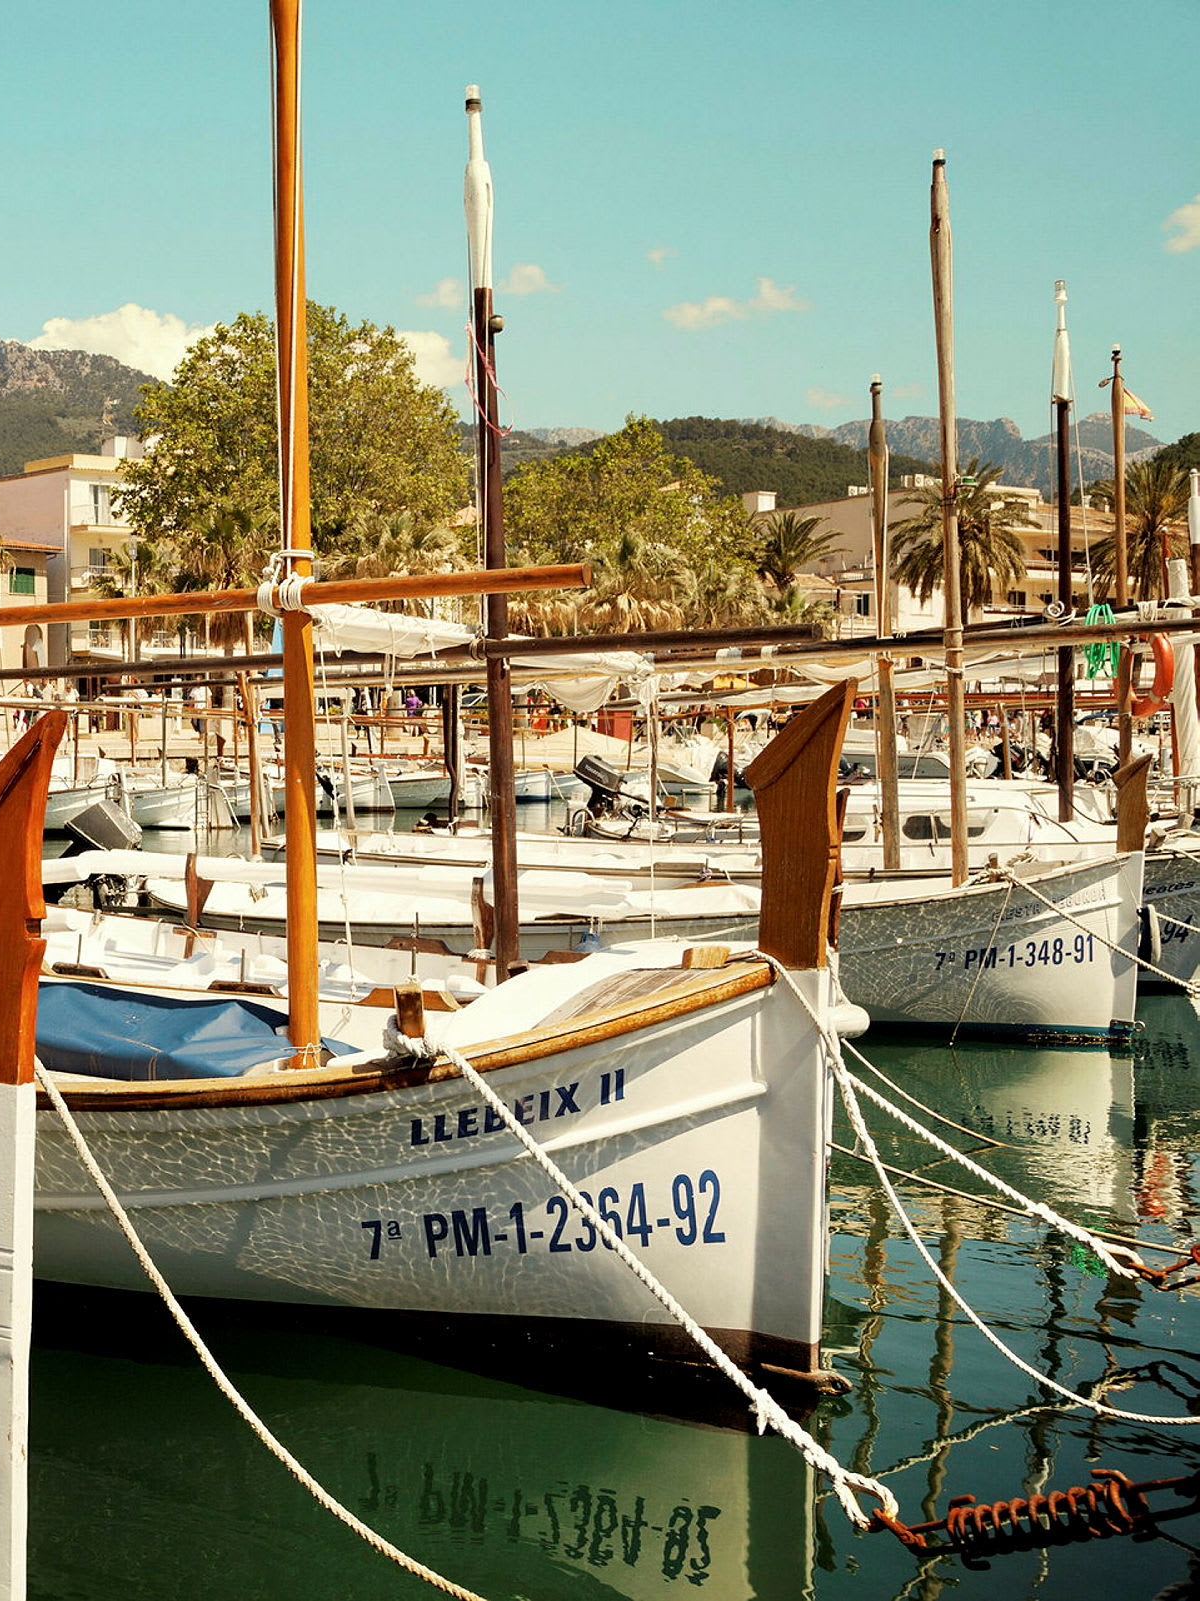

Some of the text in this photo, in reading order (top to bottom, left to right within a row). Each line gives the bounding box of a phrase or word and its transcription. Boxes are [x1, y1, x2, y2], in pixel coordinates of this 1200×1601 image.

[964, 934, 1095, 970] PM-1-348-91
[410, 1068, 626, 1146] LLEBEIX II
[423, 1169, 726, 1258] PM-1-2364-92
